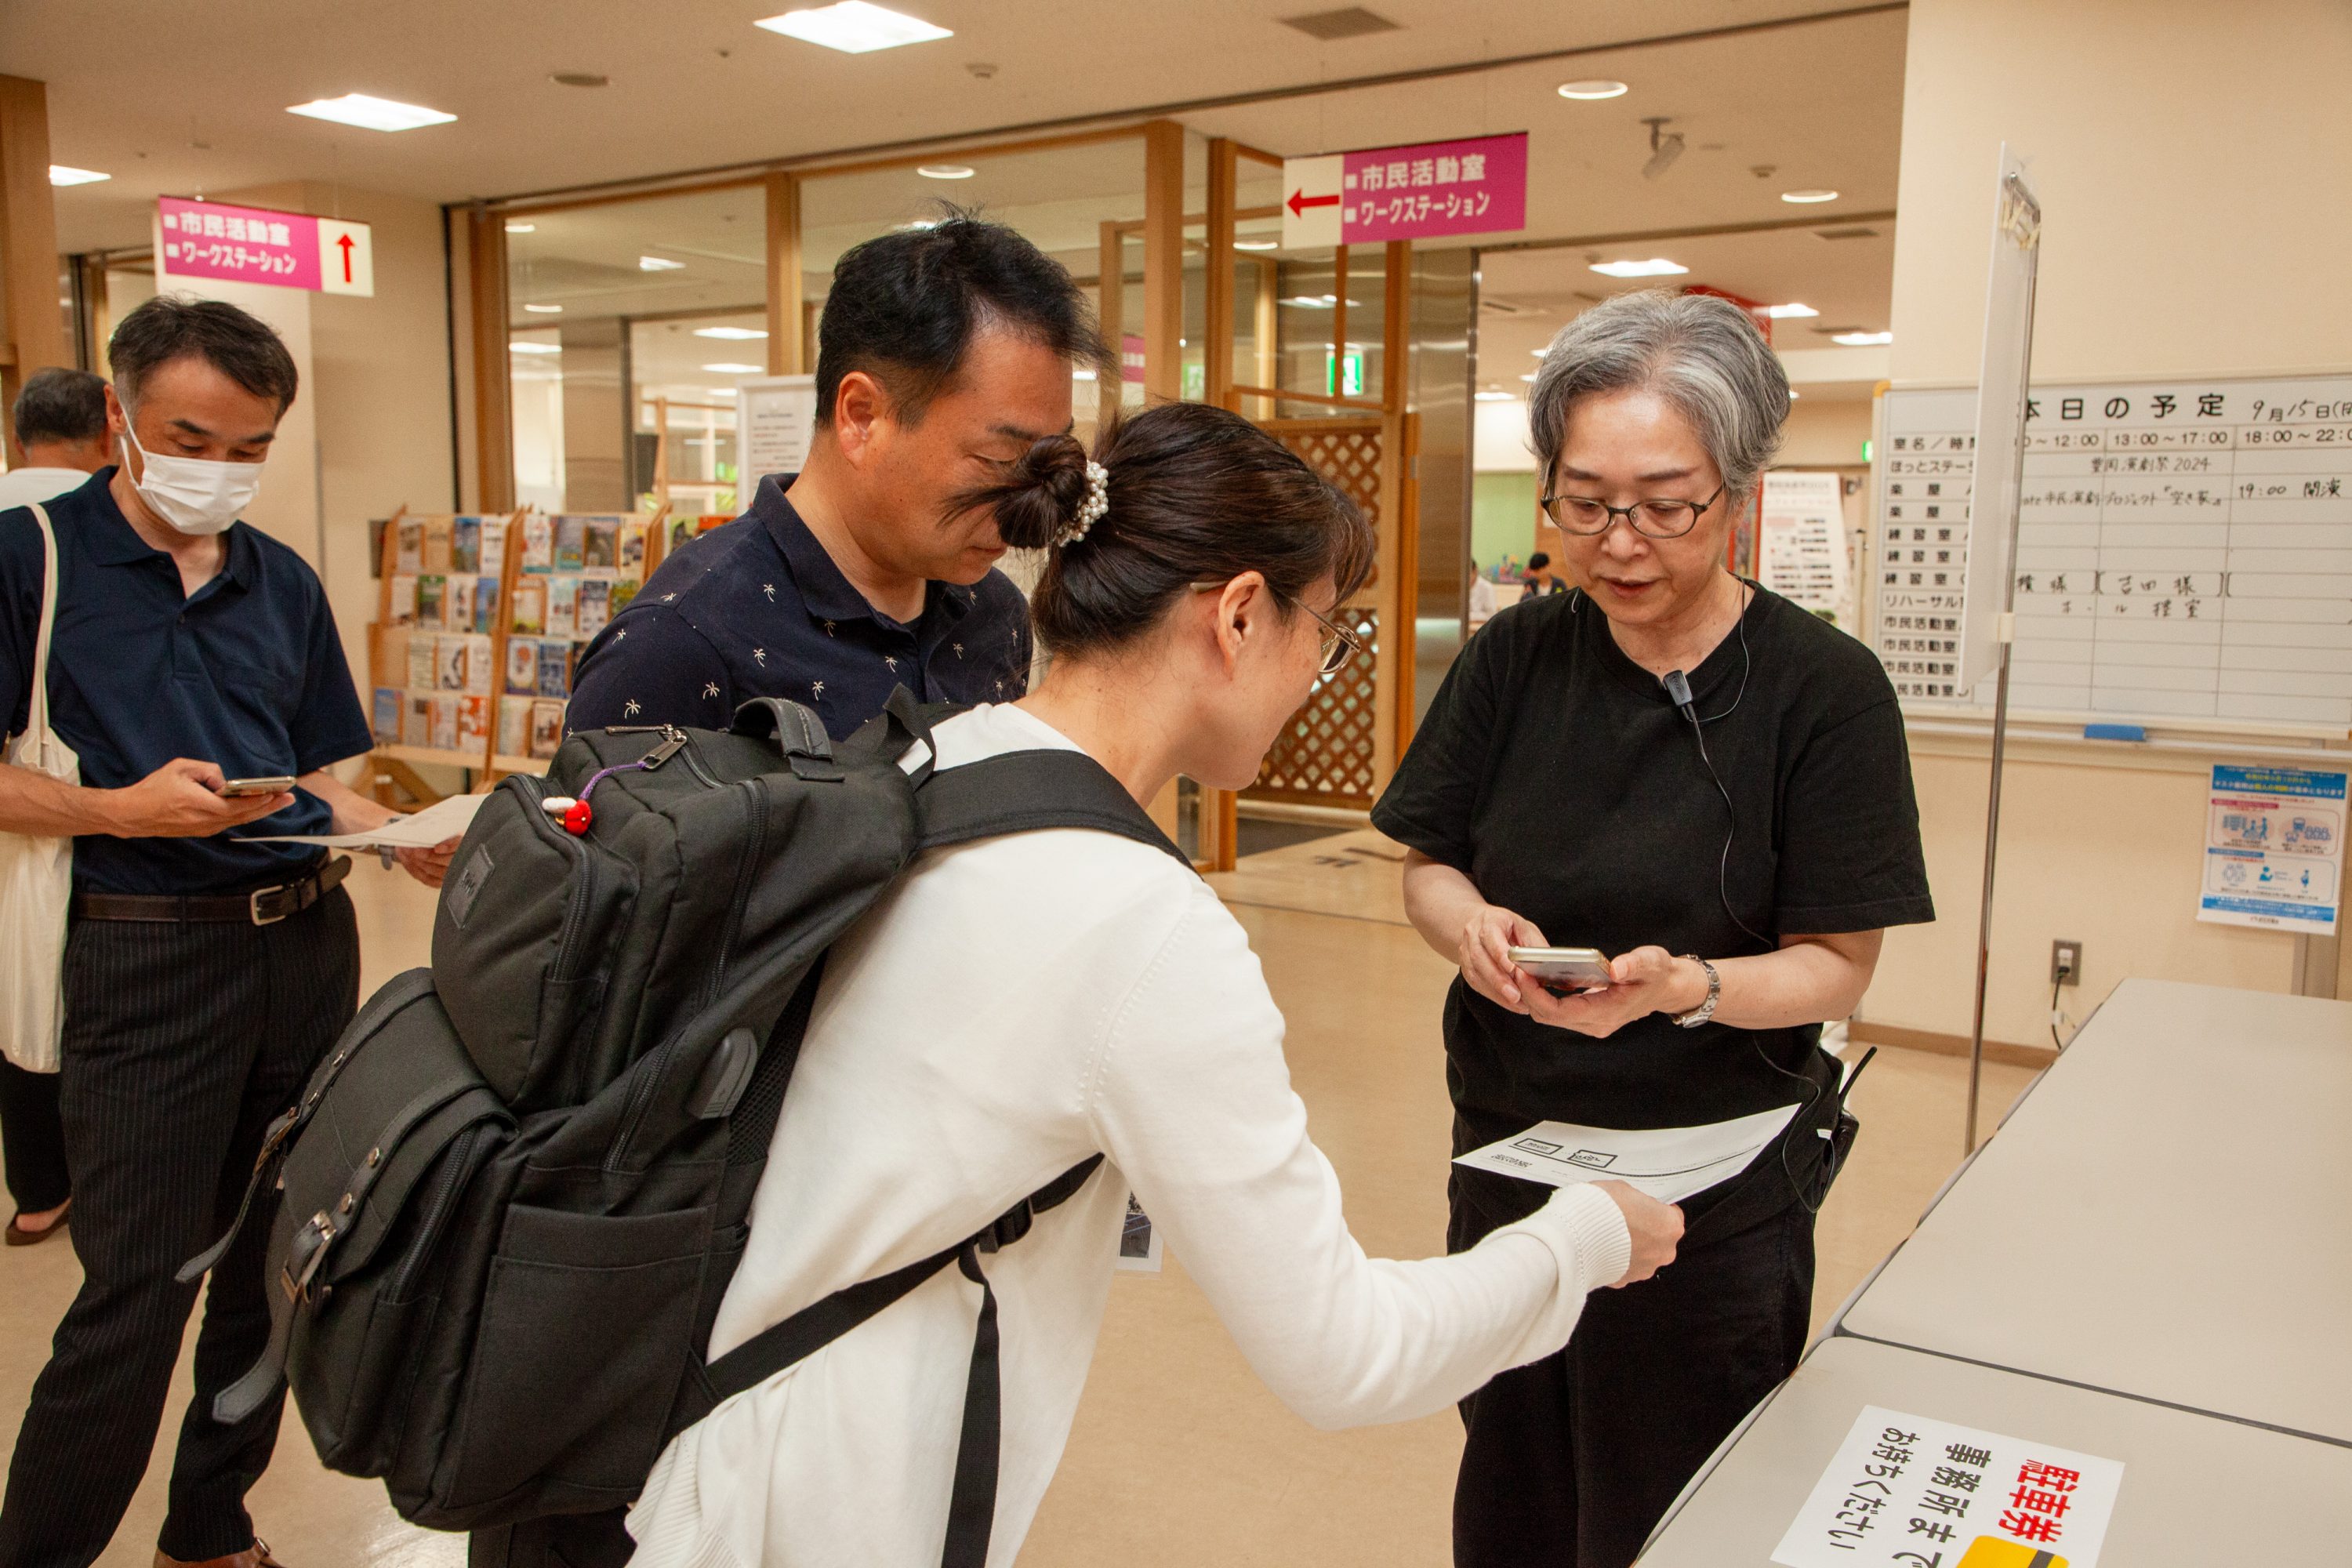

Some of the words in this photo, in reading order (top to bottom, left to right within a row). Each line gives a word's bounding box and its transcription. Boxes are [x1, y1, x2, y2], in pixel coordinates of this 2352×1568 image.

[1362, 154, 1486, 191] 市民活動室
[1360, 191, 1490, 227] ワークステーション
[180, 211, 291, 247] 市民活動室
[182, 241, 296, 274] ワークステーション
[2017, 394, 2225, 423] 本日の予定
[1885, 595, 1964, 608] リハーサル
[1828, 1427, 1921, 1550] お持ちください
[1891, 1443, 1992, 1568] 事務所まで
[1998, 1458, 2081, 1543] 駐車券
